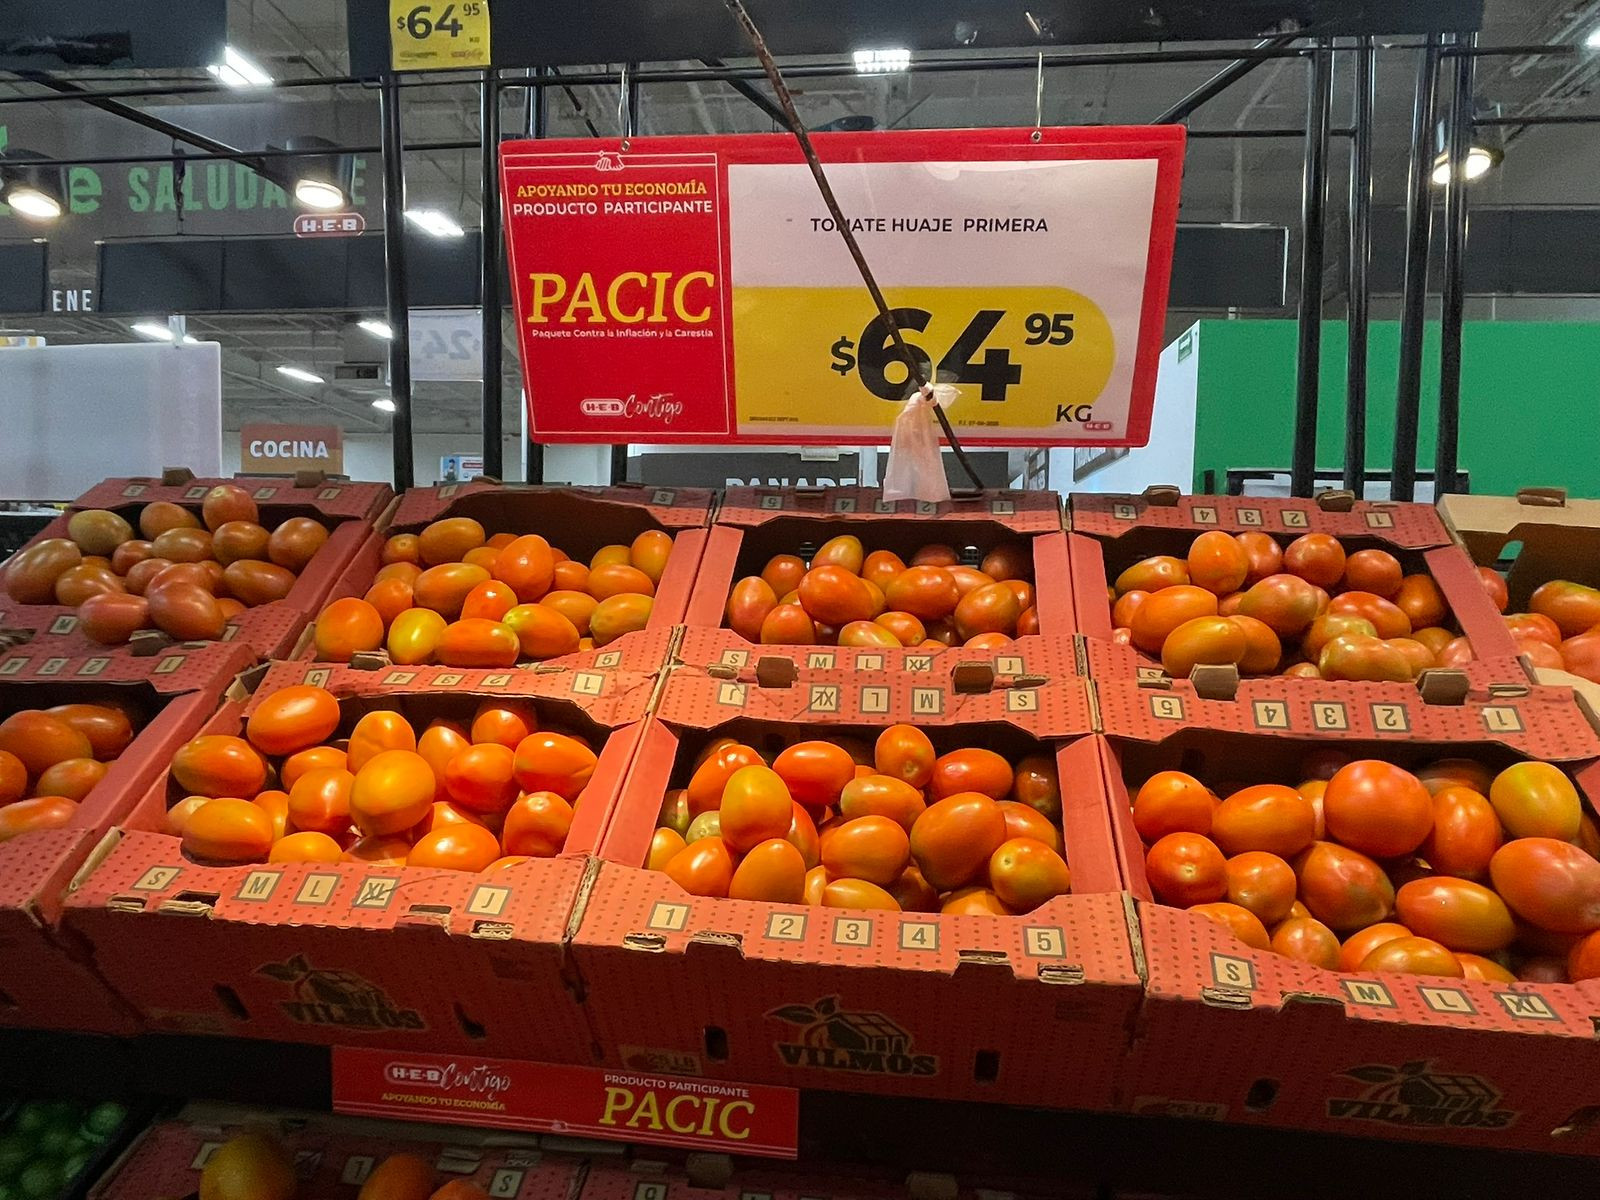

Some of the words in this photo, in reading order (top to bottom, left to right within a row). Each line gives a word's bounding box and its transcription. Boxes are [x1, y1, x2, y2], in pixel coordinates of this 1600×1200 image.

[463, 3, 480, 16] 95
[517, 183, 598, 198] APOYANDO
[601, 183, 622, 196] TU
[625, 179, 707, 196] ECONOMÍA
[513, 202, 597, 215] PRODUCTO
[604, 200, 713, 214] PARTICIPANTE
[892, 217, 953, 233] HUAJE
[963, 217, 1049, 233] PRIMERA
[527, 271, 715, 323] PACIC
[532, 329, 571, 338] Paquete
[573, 329, 605, 337] Contra
[607, 329, 614, 337] la
[616, 328, 657, 337] Inflación
[659, 331, 664, 340] y
[674, 328, 713, 337] Carestía
[1024, 313, 1074, 346] 95
[623, 394, 683, 422] Contigo
[1056, 404, 1092, 422] KG
[249, 440, 329, 458] COCINA
[1199, 510, 1210, 521] 4
[1245, 512, 1255, 522] 3
[1290, 513, 1300, 524] 2
[730, 654, 738, 663] S
[815, 657, 827, 668] M
[866, 659, 873, 668] L
[921, 694, 933, 708] M
[1018, 694, 1027, 707] S
[1162, 699, 1173, 714] 5
[1265, 706, 1276, 723] 4
[1324, 708, 1335, 724] 3
[1384, 708, 1396, 725] 2
[1500, 709, 1509, 725] 1
[148, 871, 165, 885] S
[251, 877, 270, 894] M
[310, 880, 322, 897] L
[366, 883, 386, 901] XL
[482, 892, 494, 909] J
[665, 907, 674, 927] 1
[779, 918, 793, 936] 2
[845, 922, 860, 940] 3
[912, 927, 927, 944] 4
[1037, 932, 1051, 950] 5
[1227, 960, 1240, 982] S
[1356, 985, 1381, 1002] M
[1439, 992, 1456, 1008] L
[1512, 995, 1546, 1014] XL
[777, 1042, 938, 1076] VILMOS
[440, 1063, 511, 1100] Contigo
[604, 1074, 667, 1089] PRODUCTO
[669, 1081, 749, 1098] PARTICIPANTE
[381, 1093, 437, 1105] APOYANDO
[440, 1098, 452, 1106] TU
[453, 1099, 506, 1110] ECONOMÍA
[599, 1086, 755, 1139] PACIC
[1328, 1098, 1515, 1128] VILMOS
